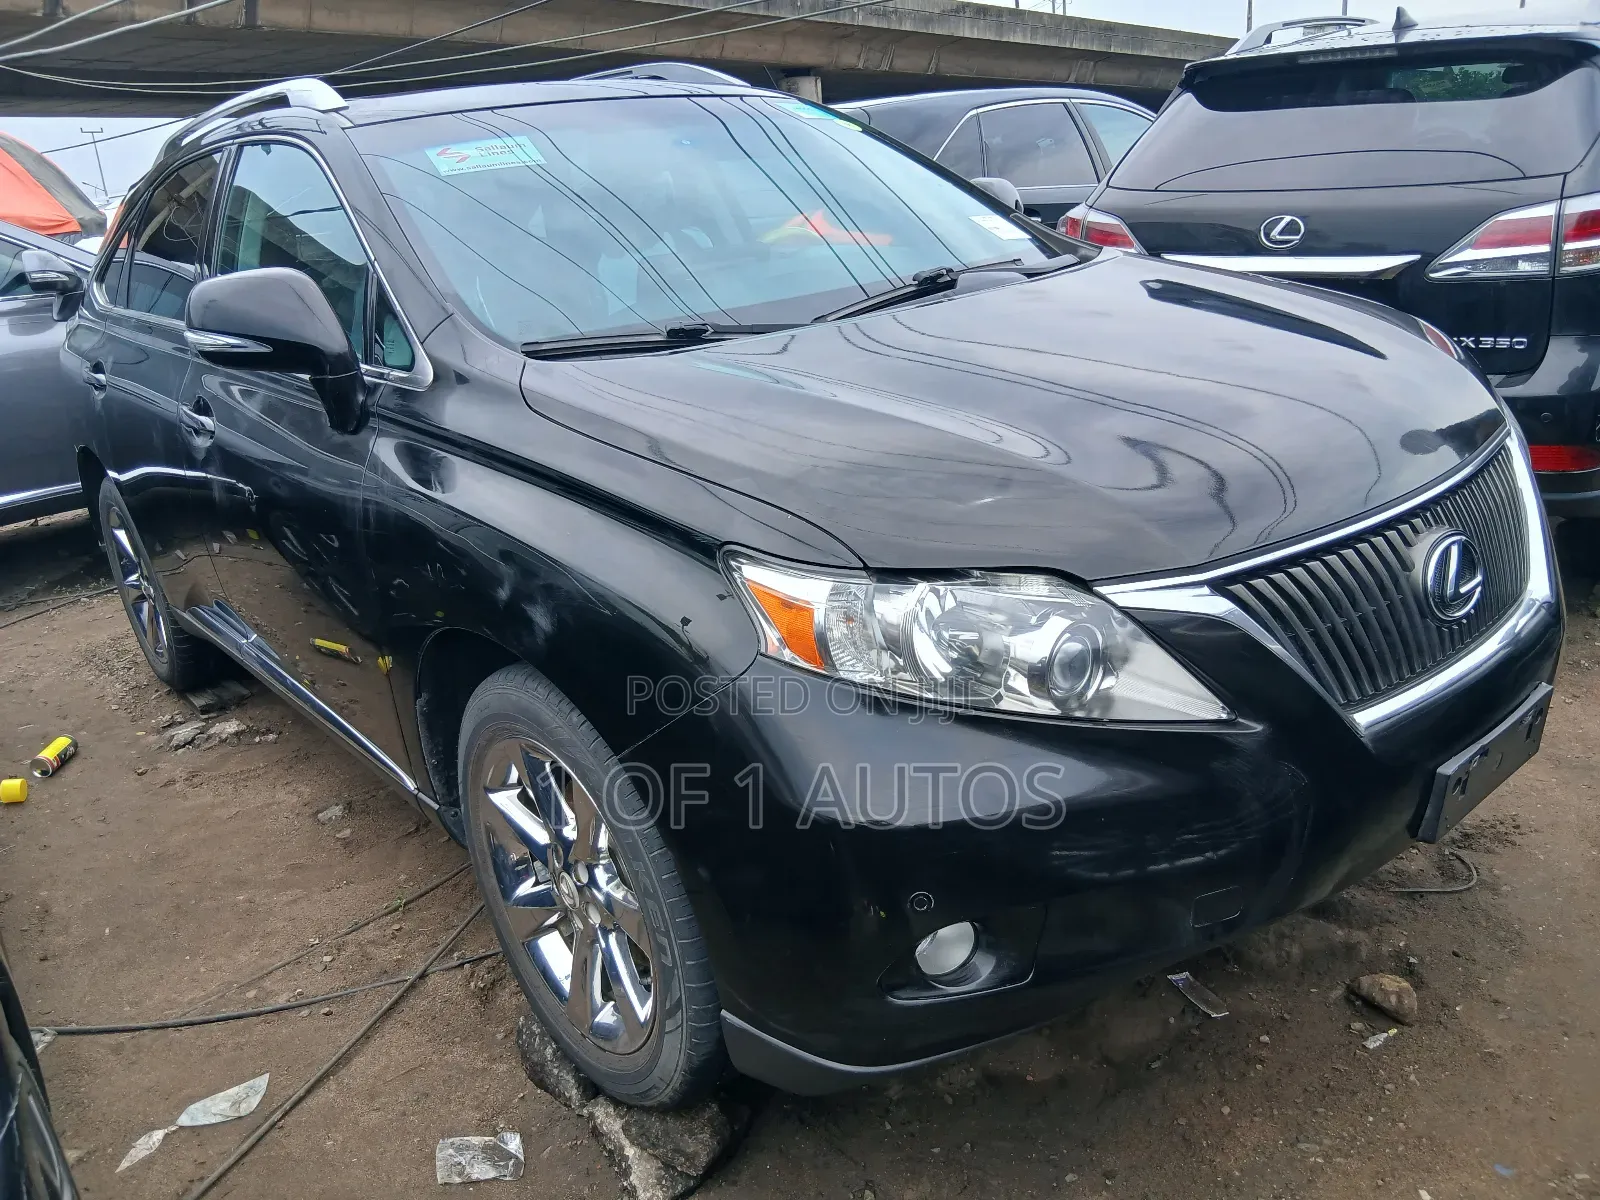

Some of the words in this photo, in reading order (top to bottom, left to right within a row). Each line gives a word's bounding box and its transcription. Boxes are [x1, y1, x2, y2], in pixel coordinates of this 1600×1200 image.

[475, 143, 527, 152] Sallaum
[480, 150, 514, 158] Lines
[1452, 337, 1476, 349] X
[1478, 337, 1528, 349] 350
